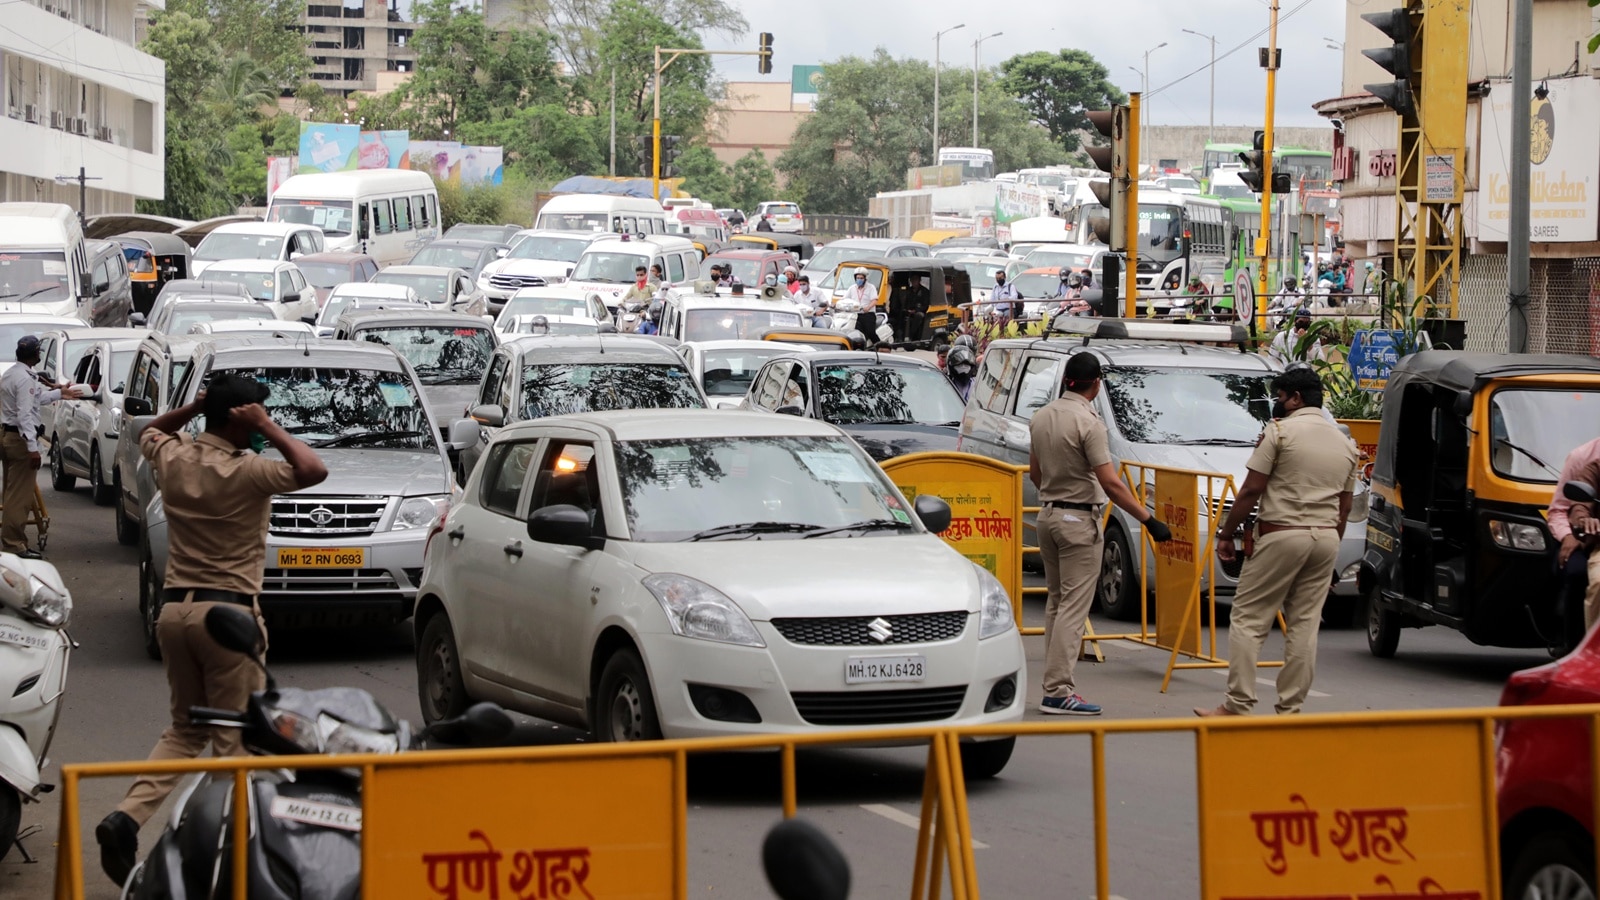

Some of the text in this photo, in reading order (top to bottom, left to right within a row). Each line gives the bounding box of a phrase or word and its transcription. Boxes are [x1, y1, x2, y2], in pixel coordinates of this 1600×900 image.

[1154, 212, 1171, 220] India
[1534, 226, 1559, 237] SAREES
[280, 554, 362, 565] MH 12 RN 0693
[1250, 793, 1417, 876] पुणे शहर
[508, 846, 596, 900] शहर
